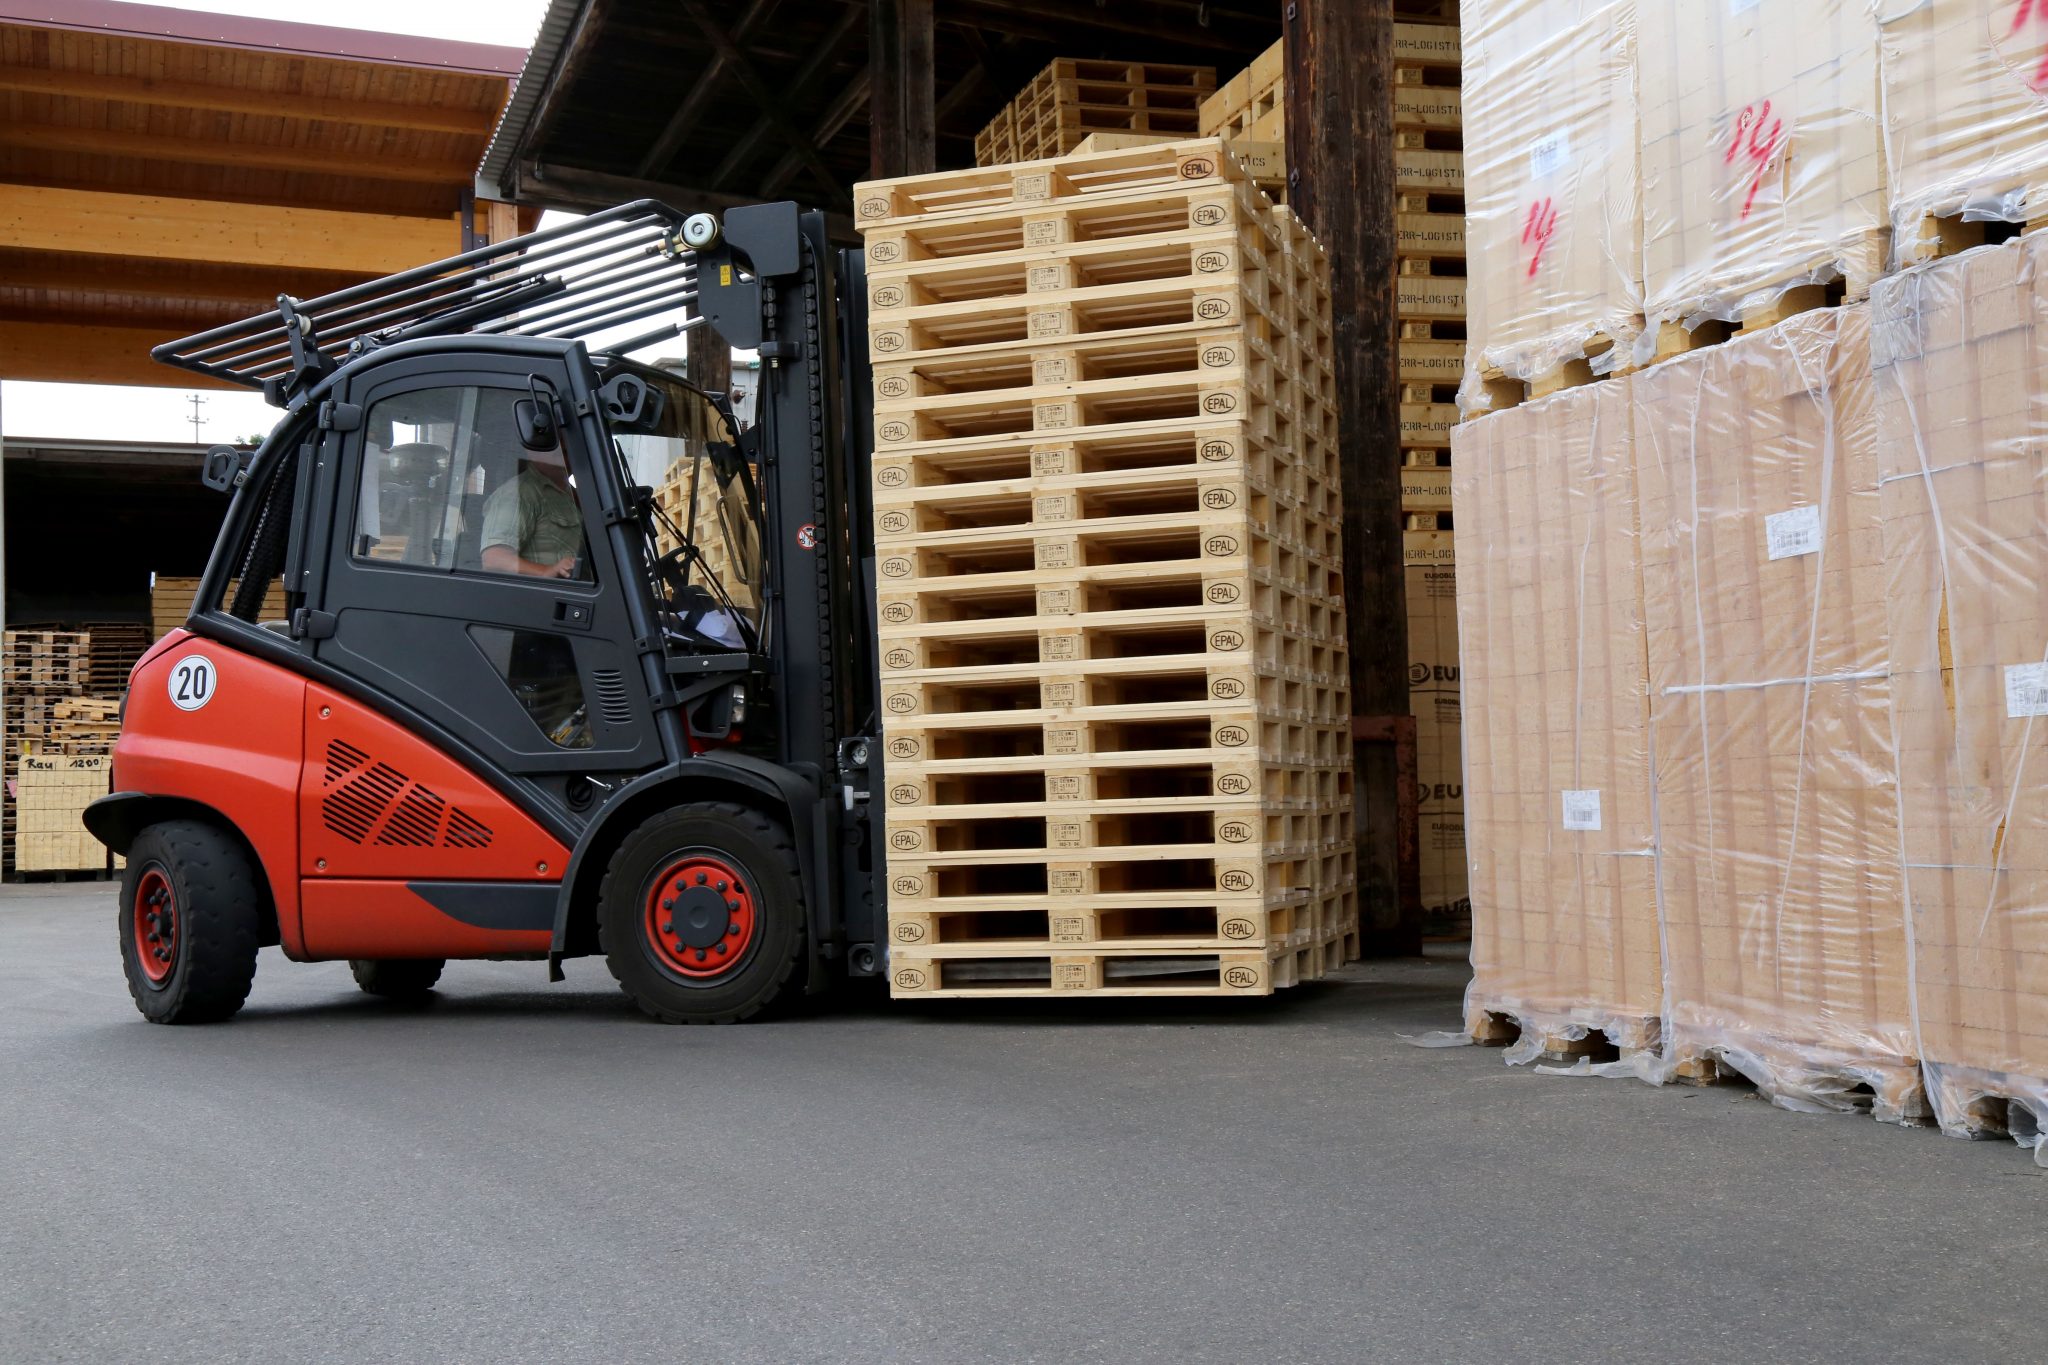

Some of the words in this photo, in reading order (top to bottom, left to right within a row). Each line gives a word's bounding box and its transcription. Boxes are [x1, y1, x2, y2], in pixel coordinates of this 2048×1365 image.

[1724, 99, 1781, 219] 14
[1185, 163, 1209, 175] EPAL
[864, 202, 886, 214] EPAL
[1197, 209, 1221, 222] EPAL
[874, 246, 896, 258] EPAL
[1200, 256, 1224, 269] EPAL
[877, 291, 899, 303] EPAL
[1201, 303, 1226, 315] EPAL
[878, 336, 900, 348] EPAL
[1206, 351, 1230, 363] EPAL
[883, 381, 905, 393] EPAL
[1207, 398, 1232, 410] EPAL
[883, 426, 905, 438] EPAL
[1205, 445, 1229, 457] EPAL
[881, 471, 903, 483] EPAL
[1207, 493, 1231, 505] EPAL
[883, 516, 905, 528] EPAL
[1209, 540, 1233, 552] EPAL
[885, 562, 907, 574] EPAL
[1211, 587, 1235, 600] EPAL
[887, 607, 909, 619] EPAL
[1214, 635, 1239, 647] EPAL
[889, 653, 911, 665] EPAL
[1433, 665, 1460, 682] EU
[177, 665, 208, 700] 20
[1216, 682, 1240, 695] EPAL
[891, 697, 913, 709] EPAL
[1220, 730, 1244, 743] EPAL
[893, 742, 915, 754] EPAL
[69, 758, 100, 769] 1200
[1222, 778, 1246, 791] EPAL
[895, 789, 917, 801] EPAL
[1224, 826, 1248, 839] EPAL
[895, 835, 917, 847] EPAL
[897, 880, 919, 892] EPAL
[1225, 875, 1249, 887] EPAL
[898, 927, 920, 939] EPAL
[1226, 923, 1250, 935] EPAL
[899, 973, 921, 985] EPAL
[1229, 971, 1253, 984] EPAL
